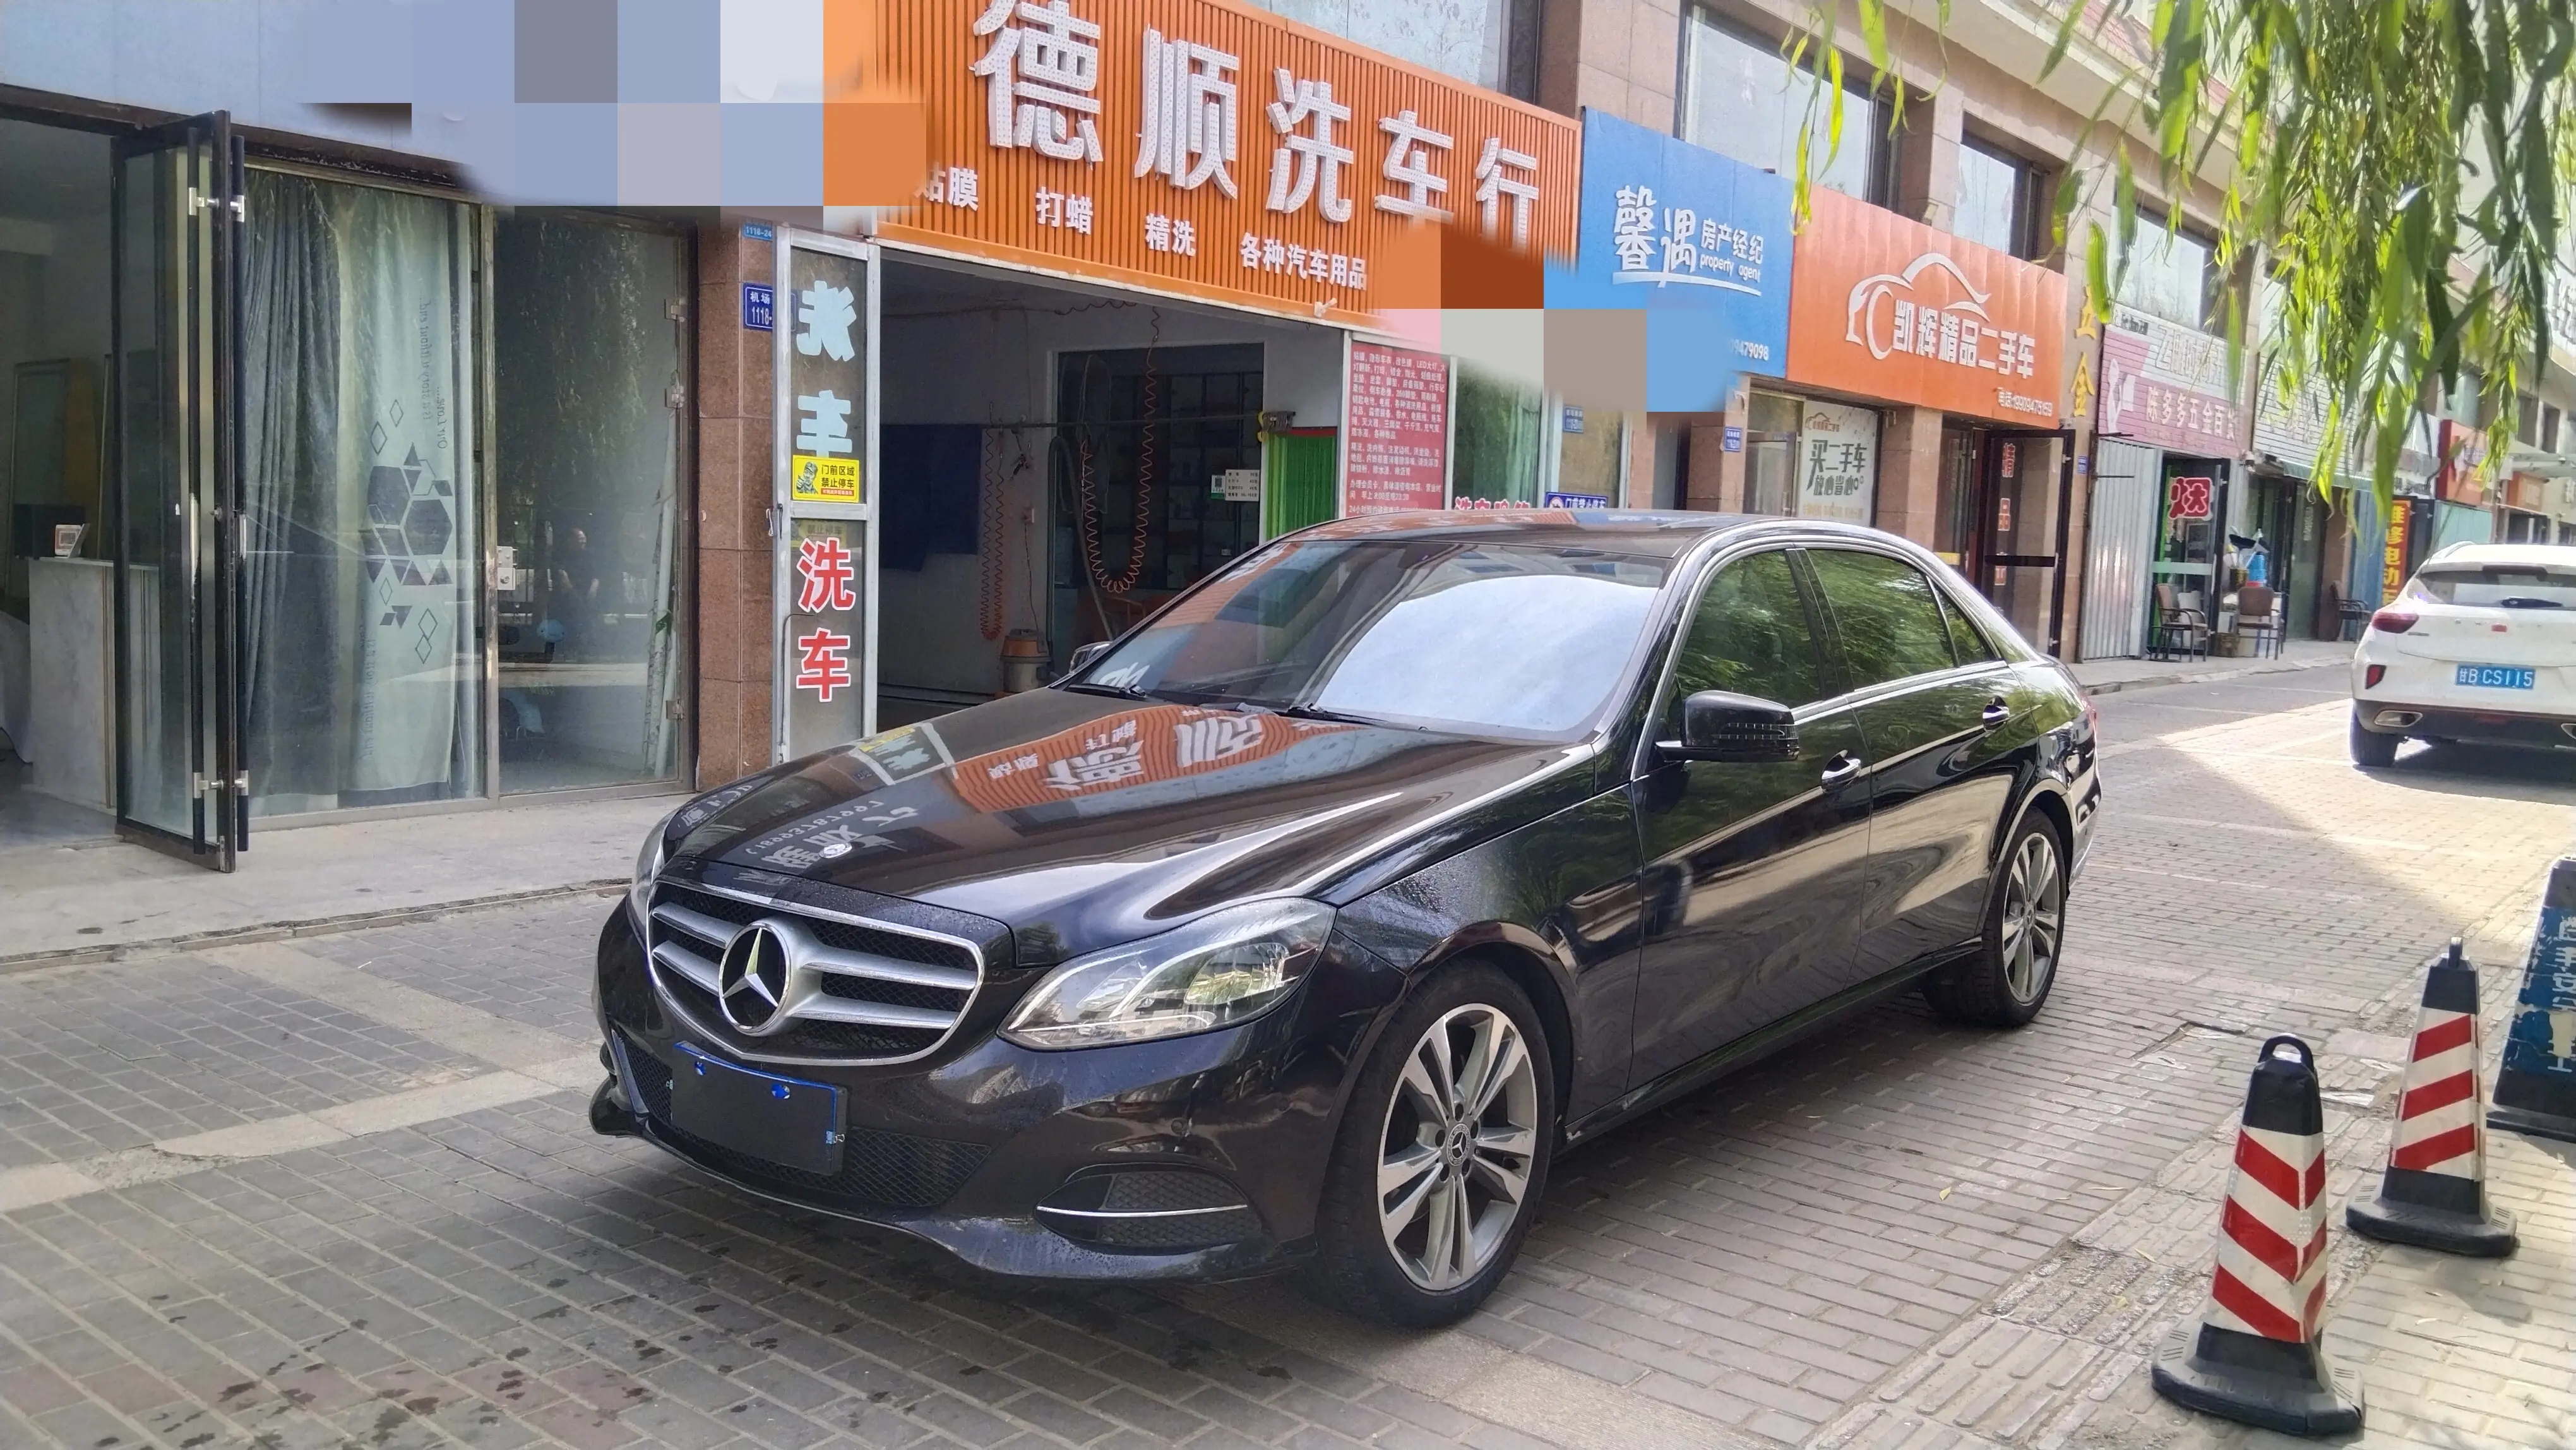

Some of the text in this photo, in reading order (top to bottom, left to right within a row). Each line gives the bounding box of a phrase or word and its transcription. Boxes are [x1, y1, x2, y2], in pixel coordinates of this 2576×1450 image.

[972, 0, 1539, 249] 德顺洗车行
[1035, 187, 1093, 235] 打蜡
[1145, 213, 1196, 257] 精洗
[1239, 232, 1367, 291] 各种汽车用品
[1702, 219, 1764, 264] 房产经纪
[1700, 253, 1760, 283] property agent
[1893, 299, 2035, 379] 凯辉精品二手车
[821, 464, 855, 477] 门前区域
[821, 477, 855, 489] 禁止停车
[1806, 439, 1867, 491] 买二手车
[796, 537, 856, 702] 洗车
